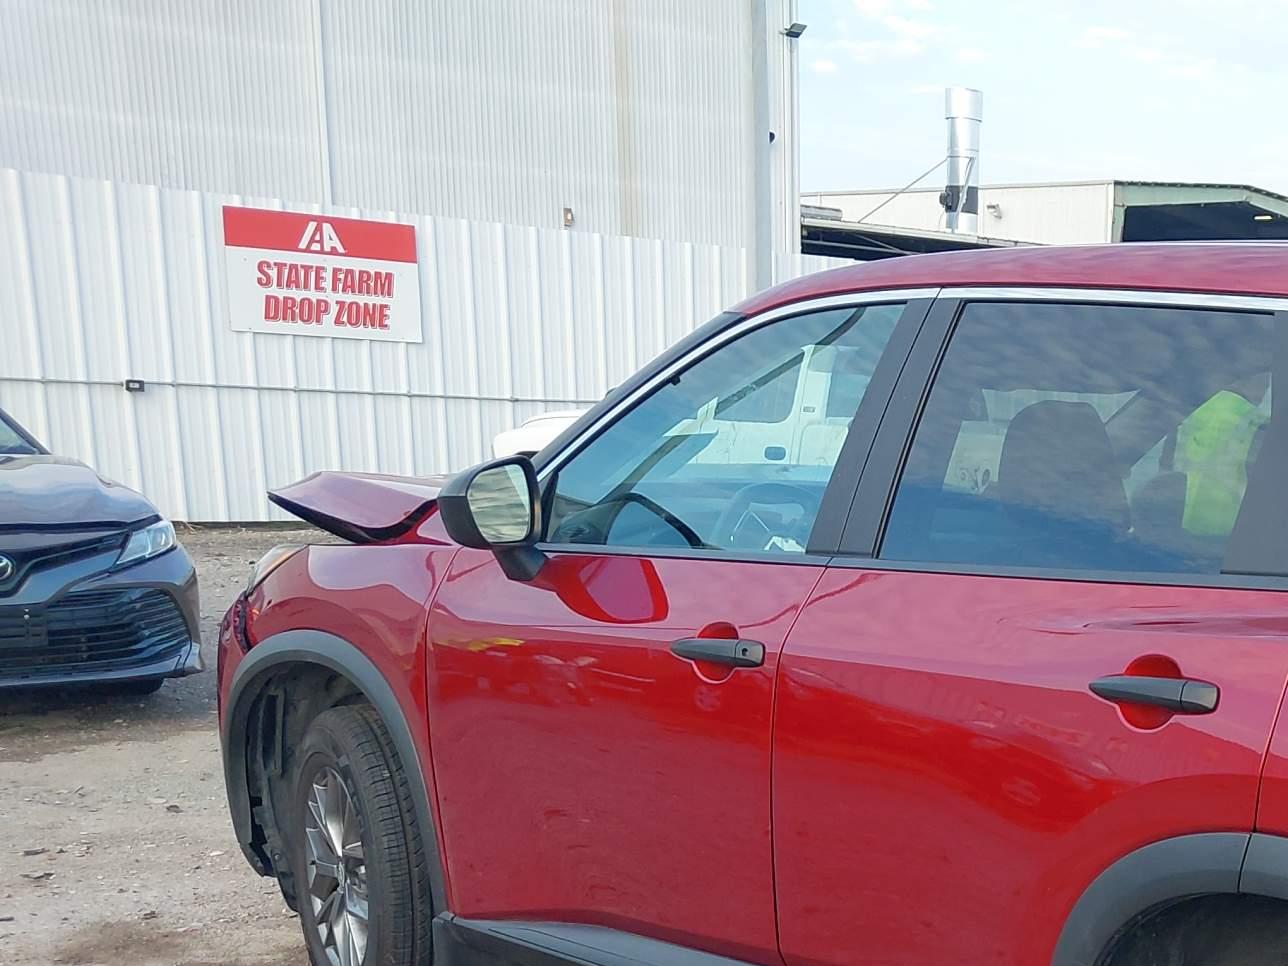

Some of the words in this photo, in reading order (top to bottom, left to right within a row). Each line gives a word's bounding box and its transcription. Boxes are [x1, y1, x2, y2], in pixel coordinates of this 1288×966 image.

[257, 261, 326, 292] STATE
[331, 267, 395, 298] FARM
[264, 294, 330, 325] DROP
[333, 300, 391, 330] ZONE
